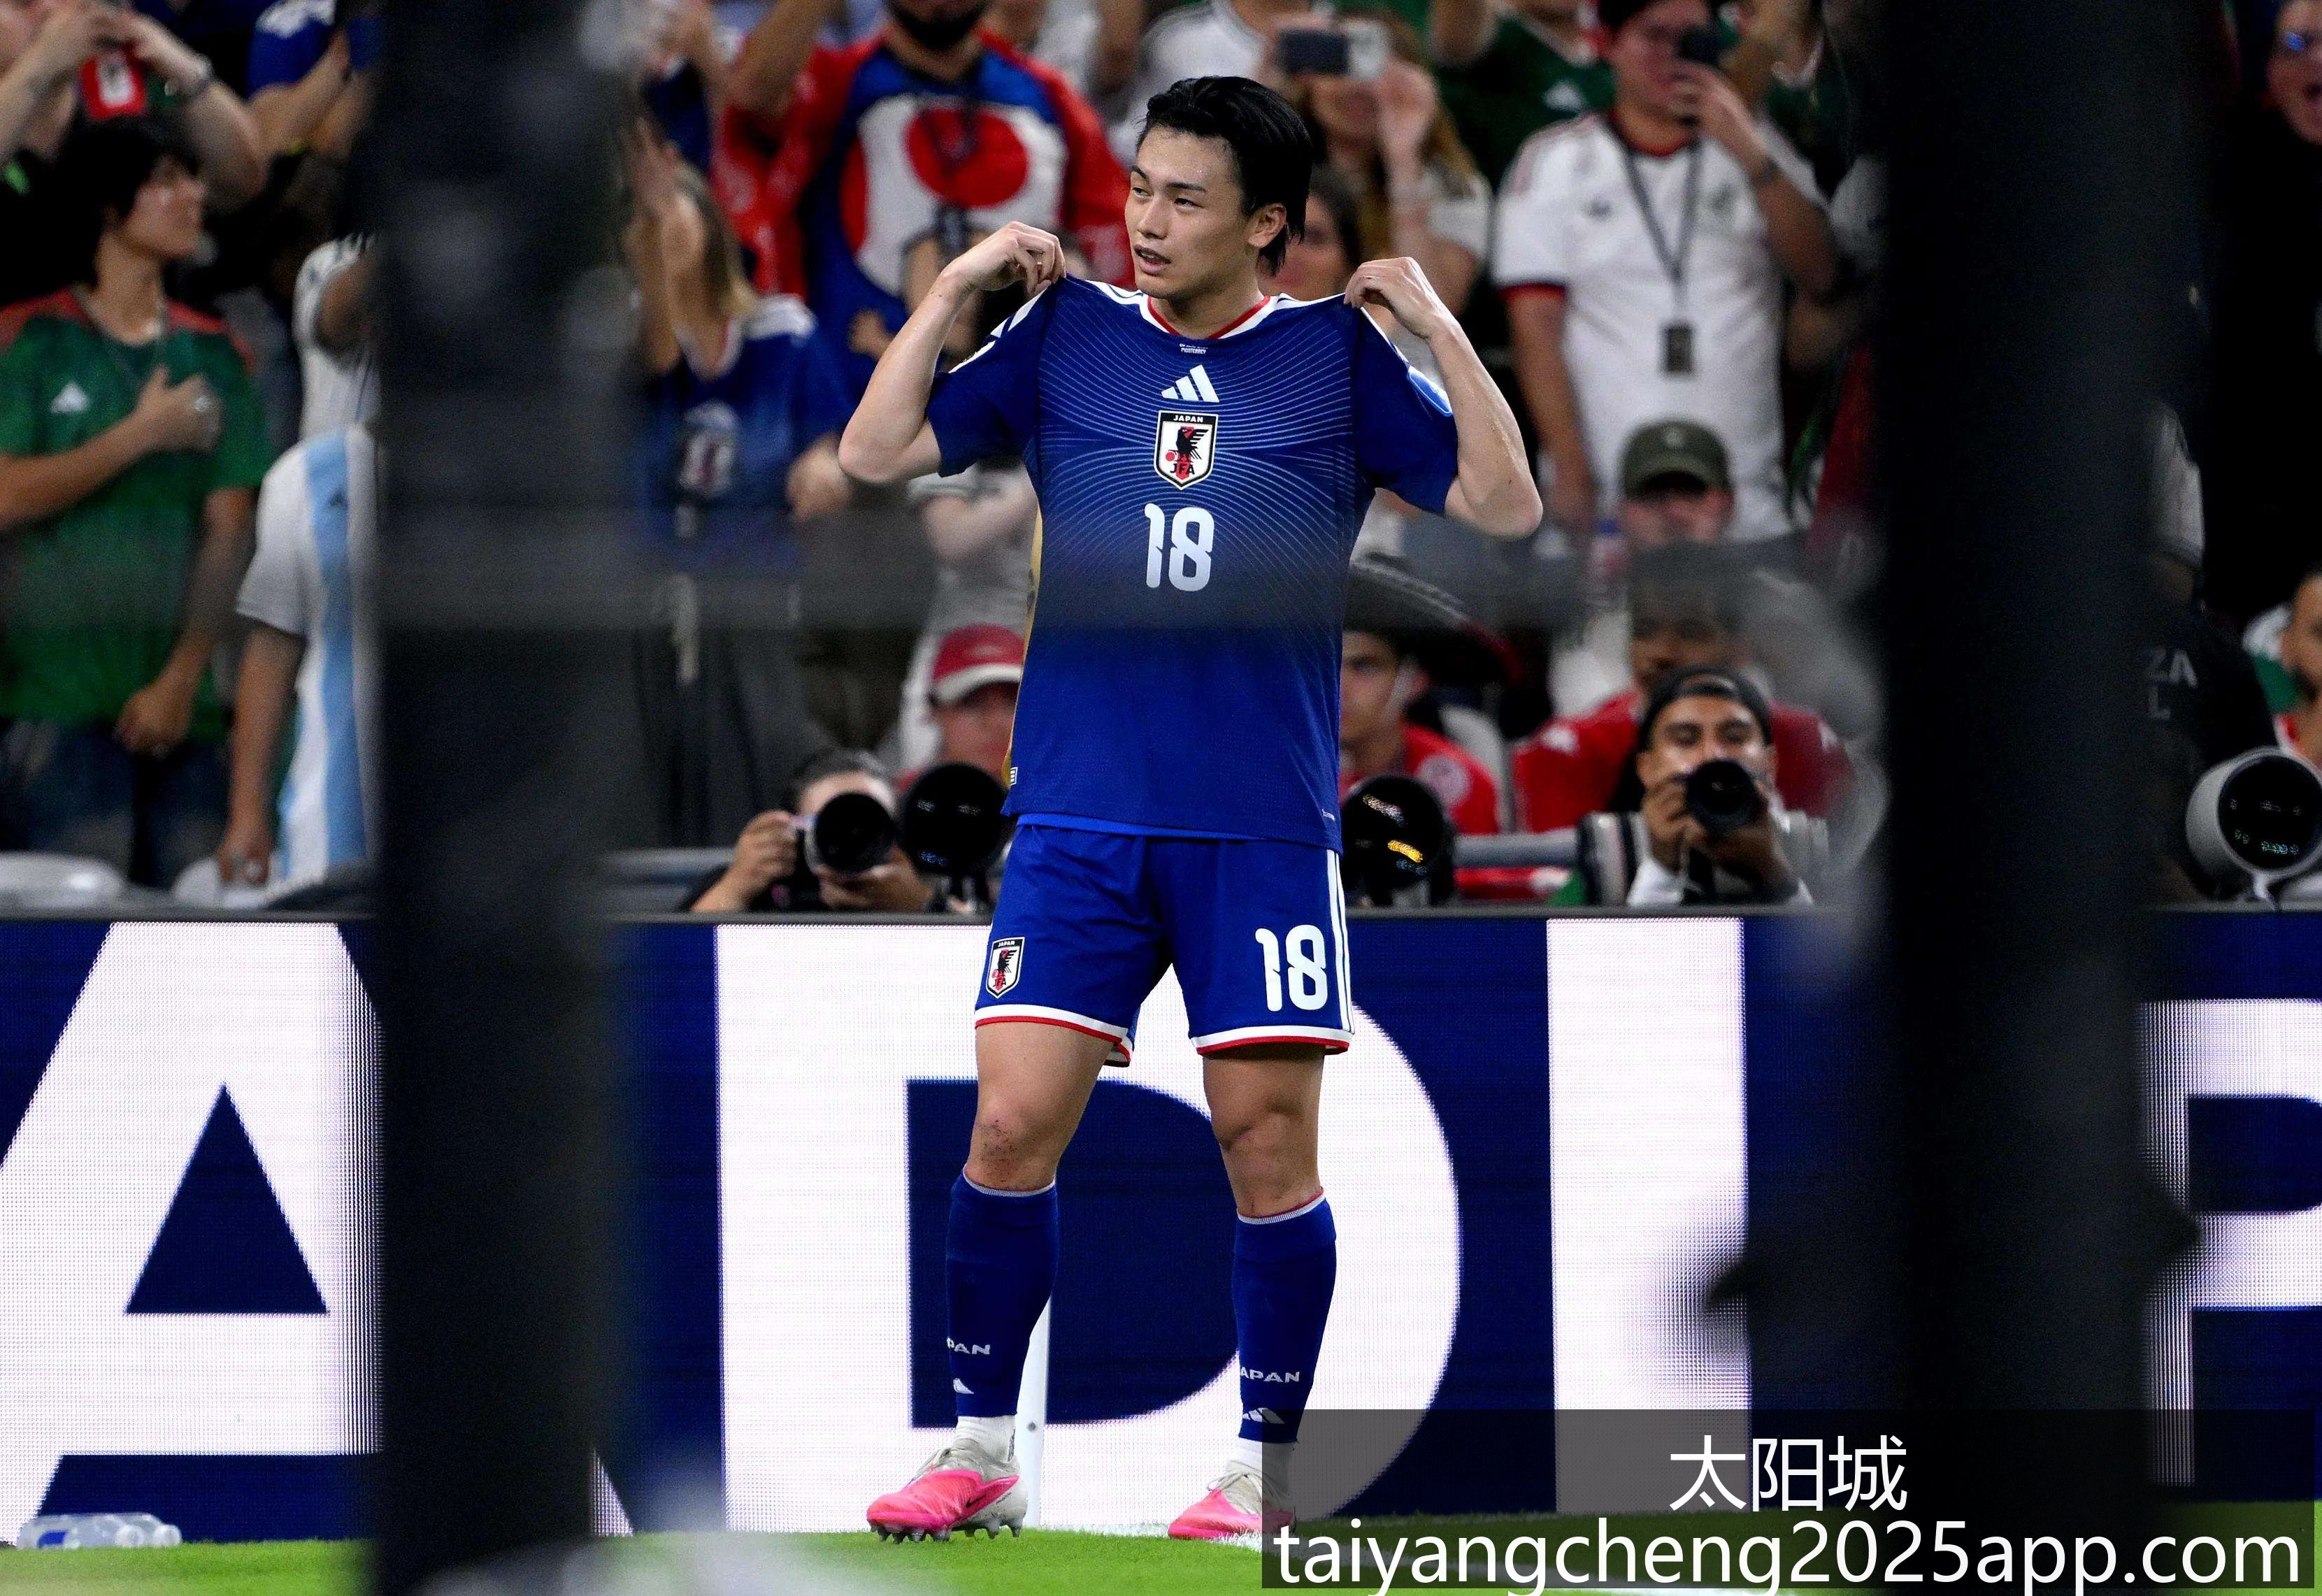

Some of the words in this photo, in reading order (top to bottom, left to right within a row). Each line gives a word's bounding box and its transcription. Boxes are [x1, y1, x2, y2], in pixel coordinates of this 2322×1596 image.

[1173, 415, 1204, 423] JAPAN
[1170, 462, 1196, 475] JFA
[1144, 503, 1214, 592] 18
[1255, 924, 1328, 1012] 18
[947, 1337, 991, 1355] PAN
[1240, 1367, 1300, 1383] APAN
